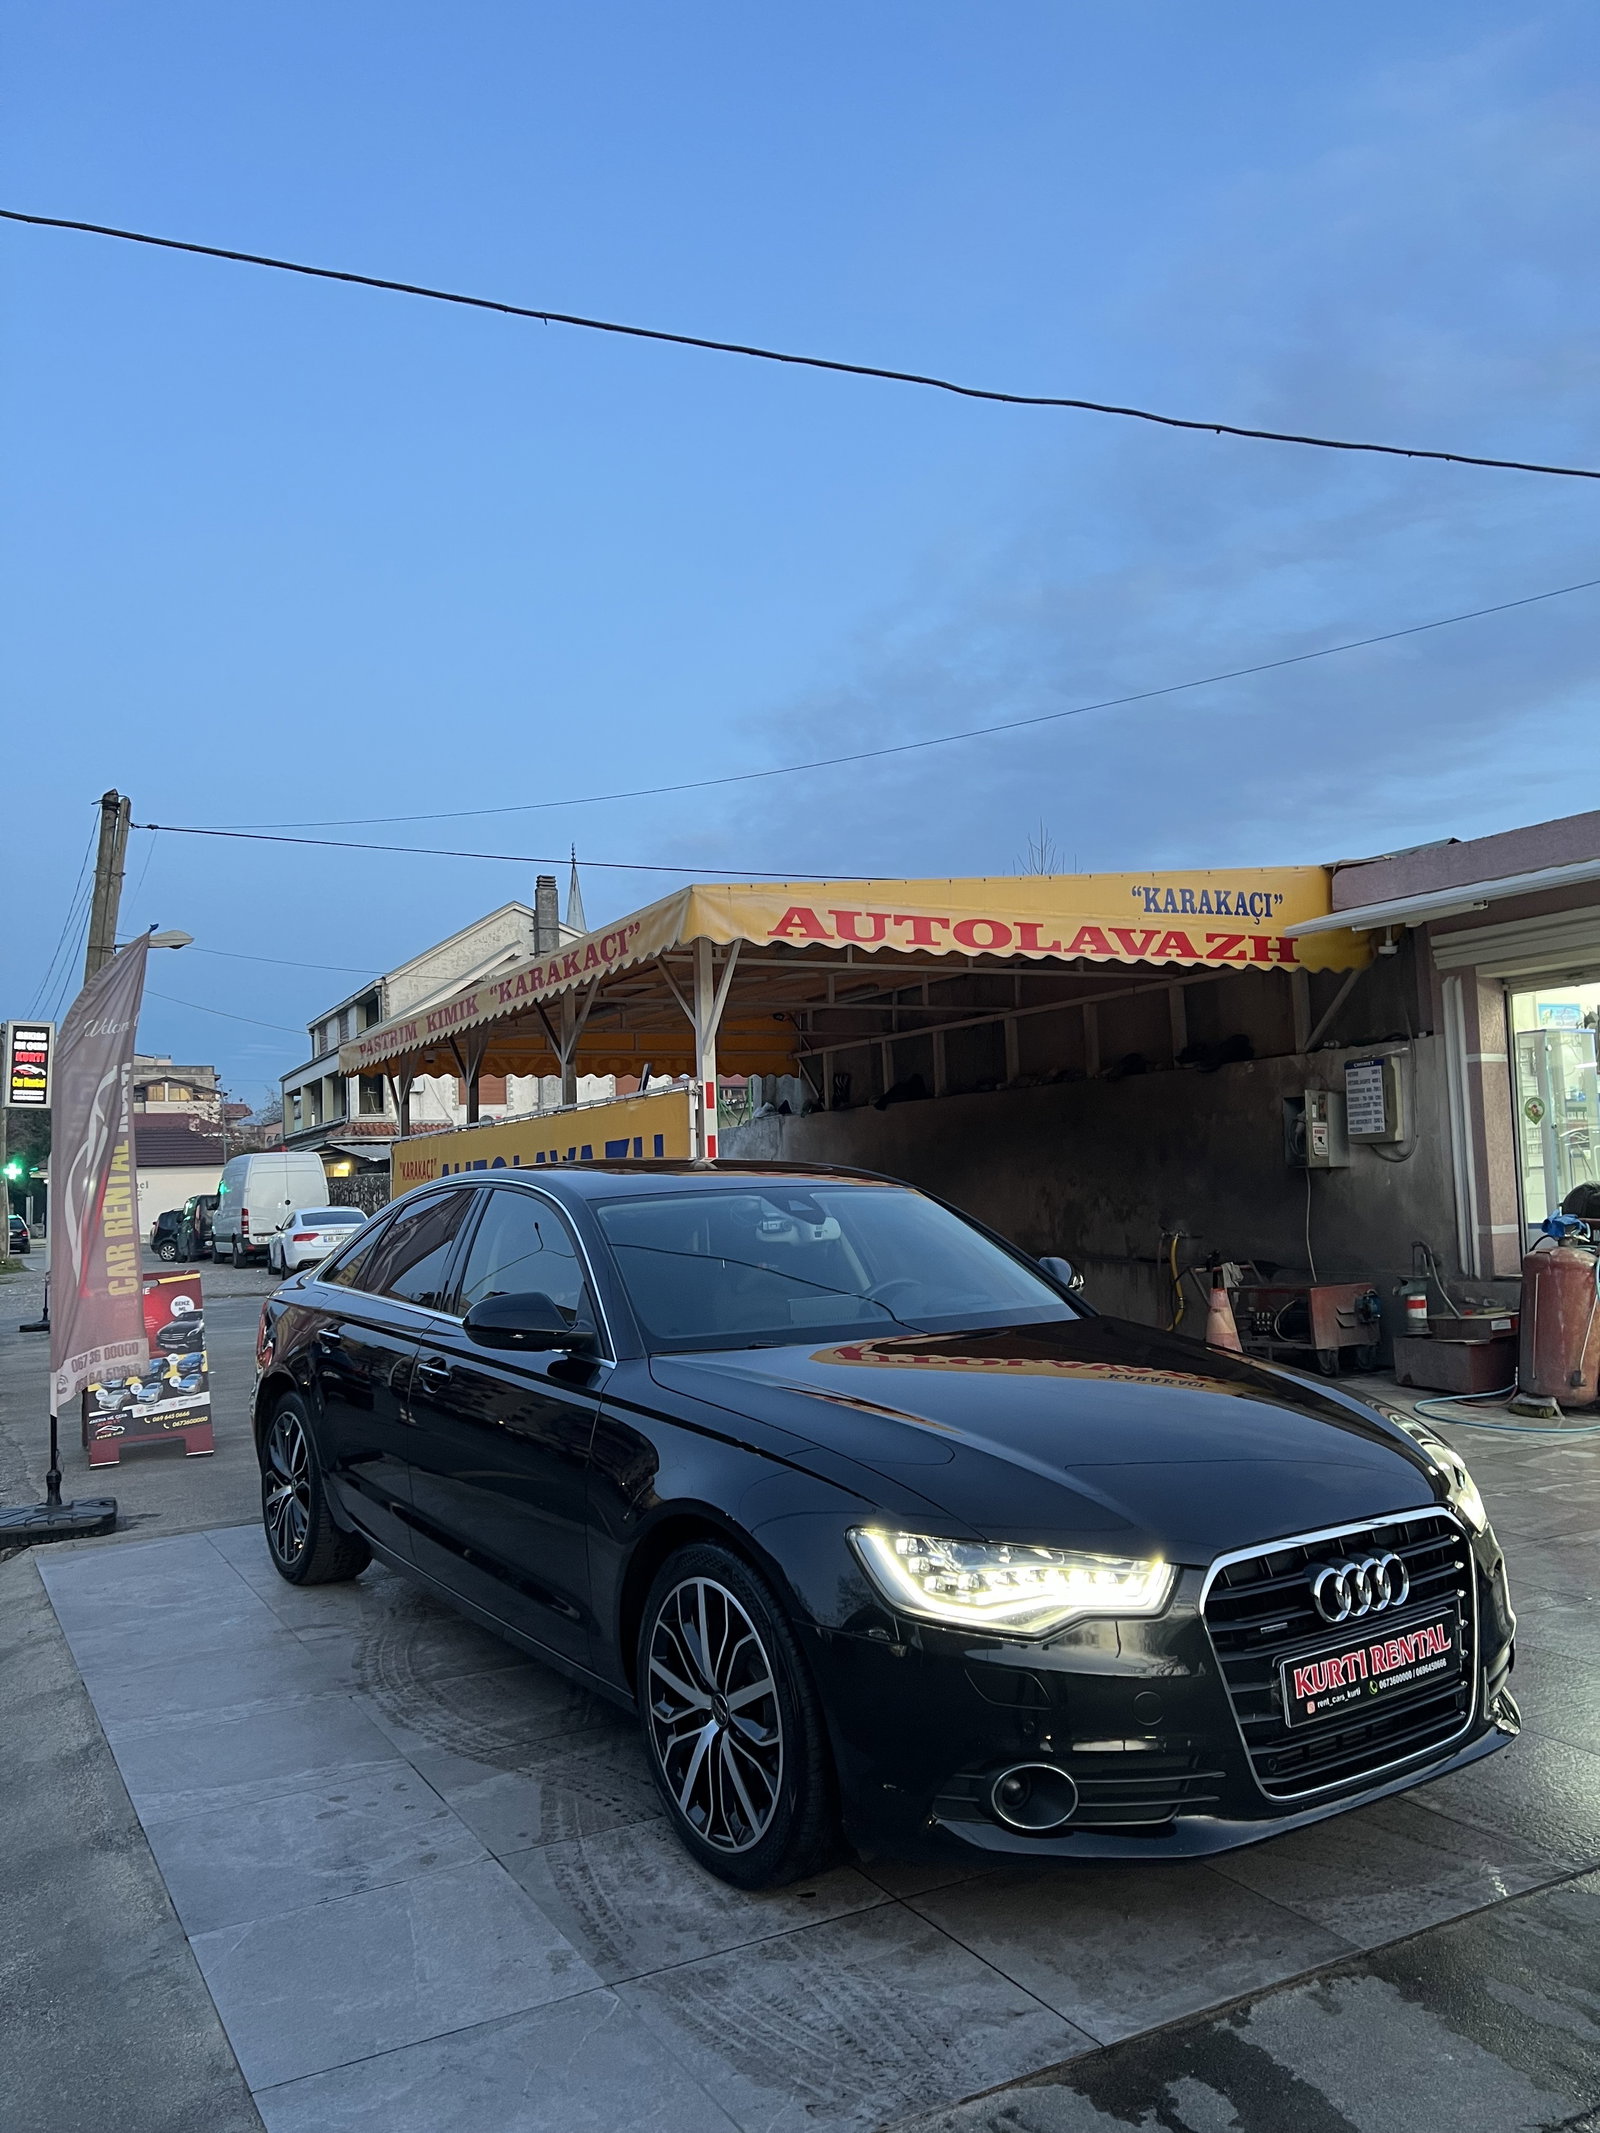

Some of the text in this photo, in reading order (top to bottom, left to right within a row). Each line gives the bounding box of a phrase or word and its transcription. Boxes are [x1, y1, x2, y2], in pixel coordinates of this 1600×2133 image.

[767, 906, 1300, 963] AUTOLAVAZH
[359, 1021, 418, 1055] PASTRIM
[426, 994, 479, 1034] KIMIK
[106, 1242, 138, 1296] CAR
[1293, 1623, 1452, 1699] KURTI RENTAL
